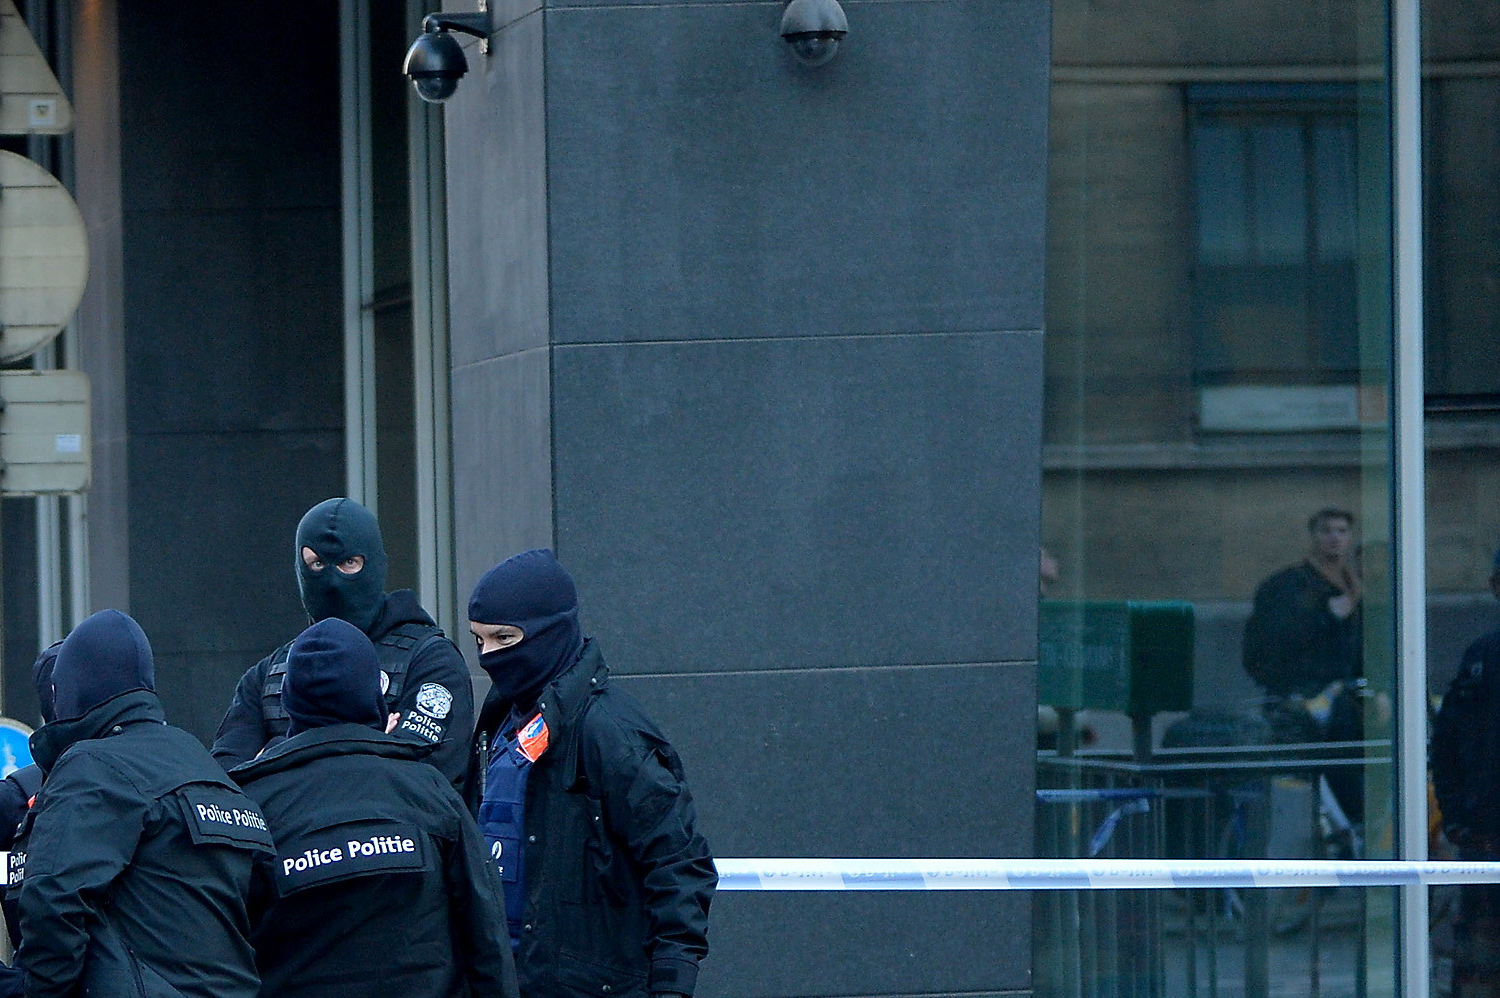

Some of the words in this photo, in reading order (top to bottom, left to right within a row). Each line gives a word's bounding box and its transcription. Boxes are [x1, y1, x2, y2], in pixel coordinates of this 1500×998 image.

[401, 721, 439, 742] Politie
[407, 711, 442, 733] Police
[196, 803, 233, 825] Police
[232, 809, 267, 831] Politie
[283, 847, 343, 876] Police
[348, 835, 415, 858] Politie
